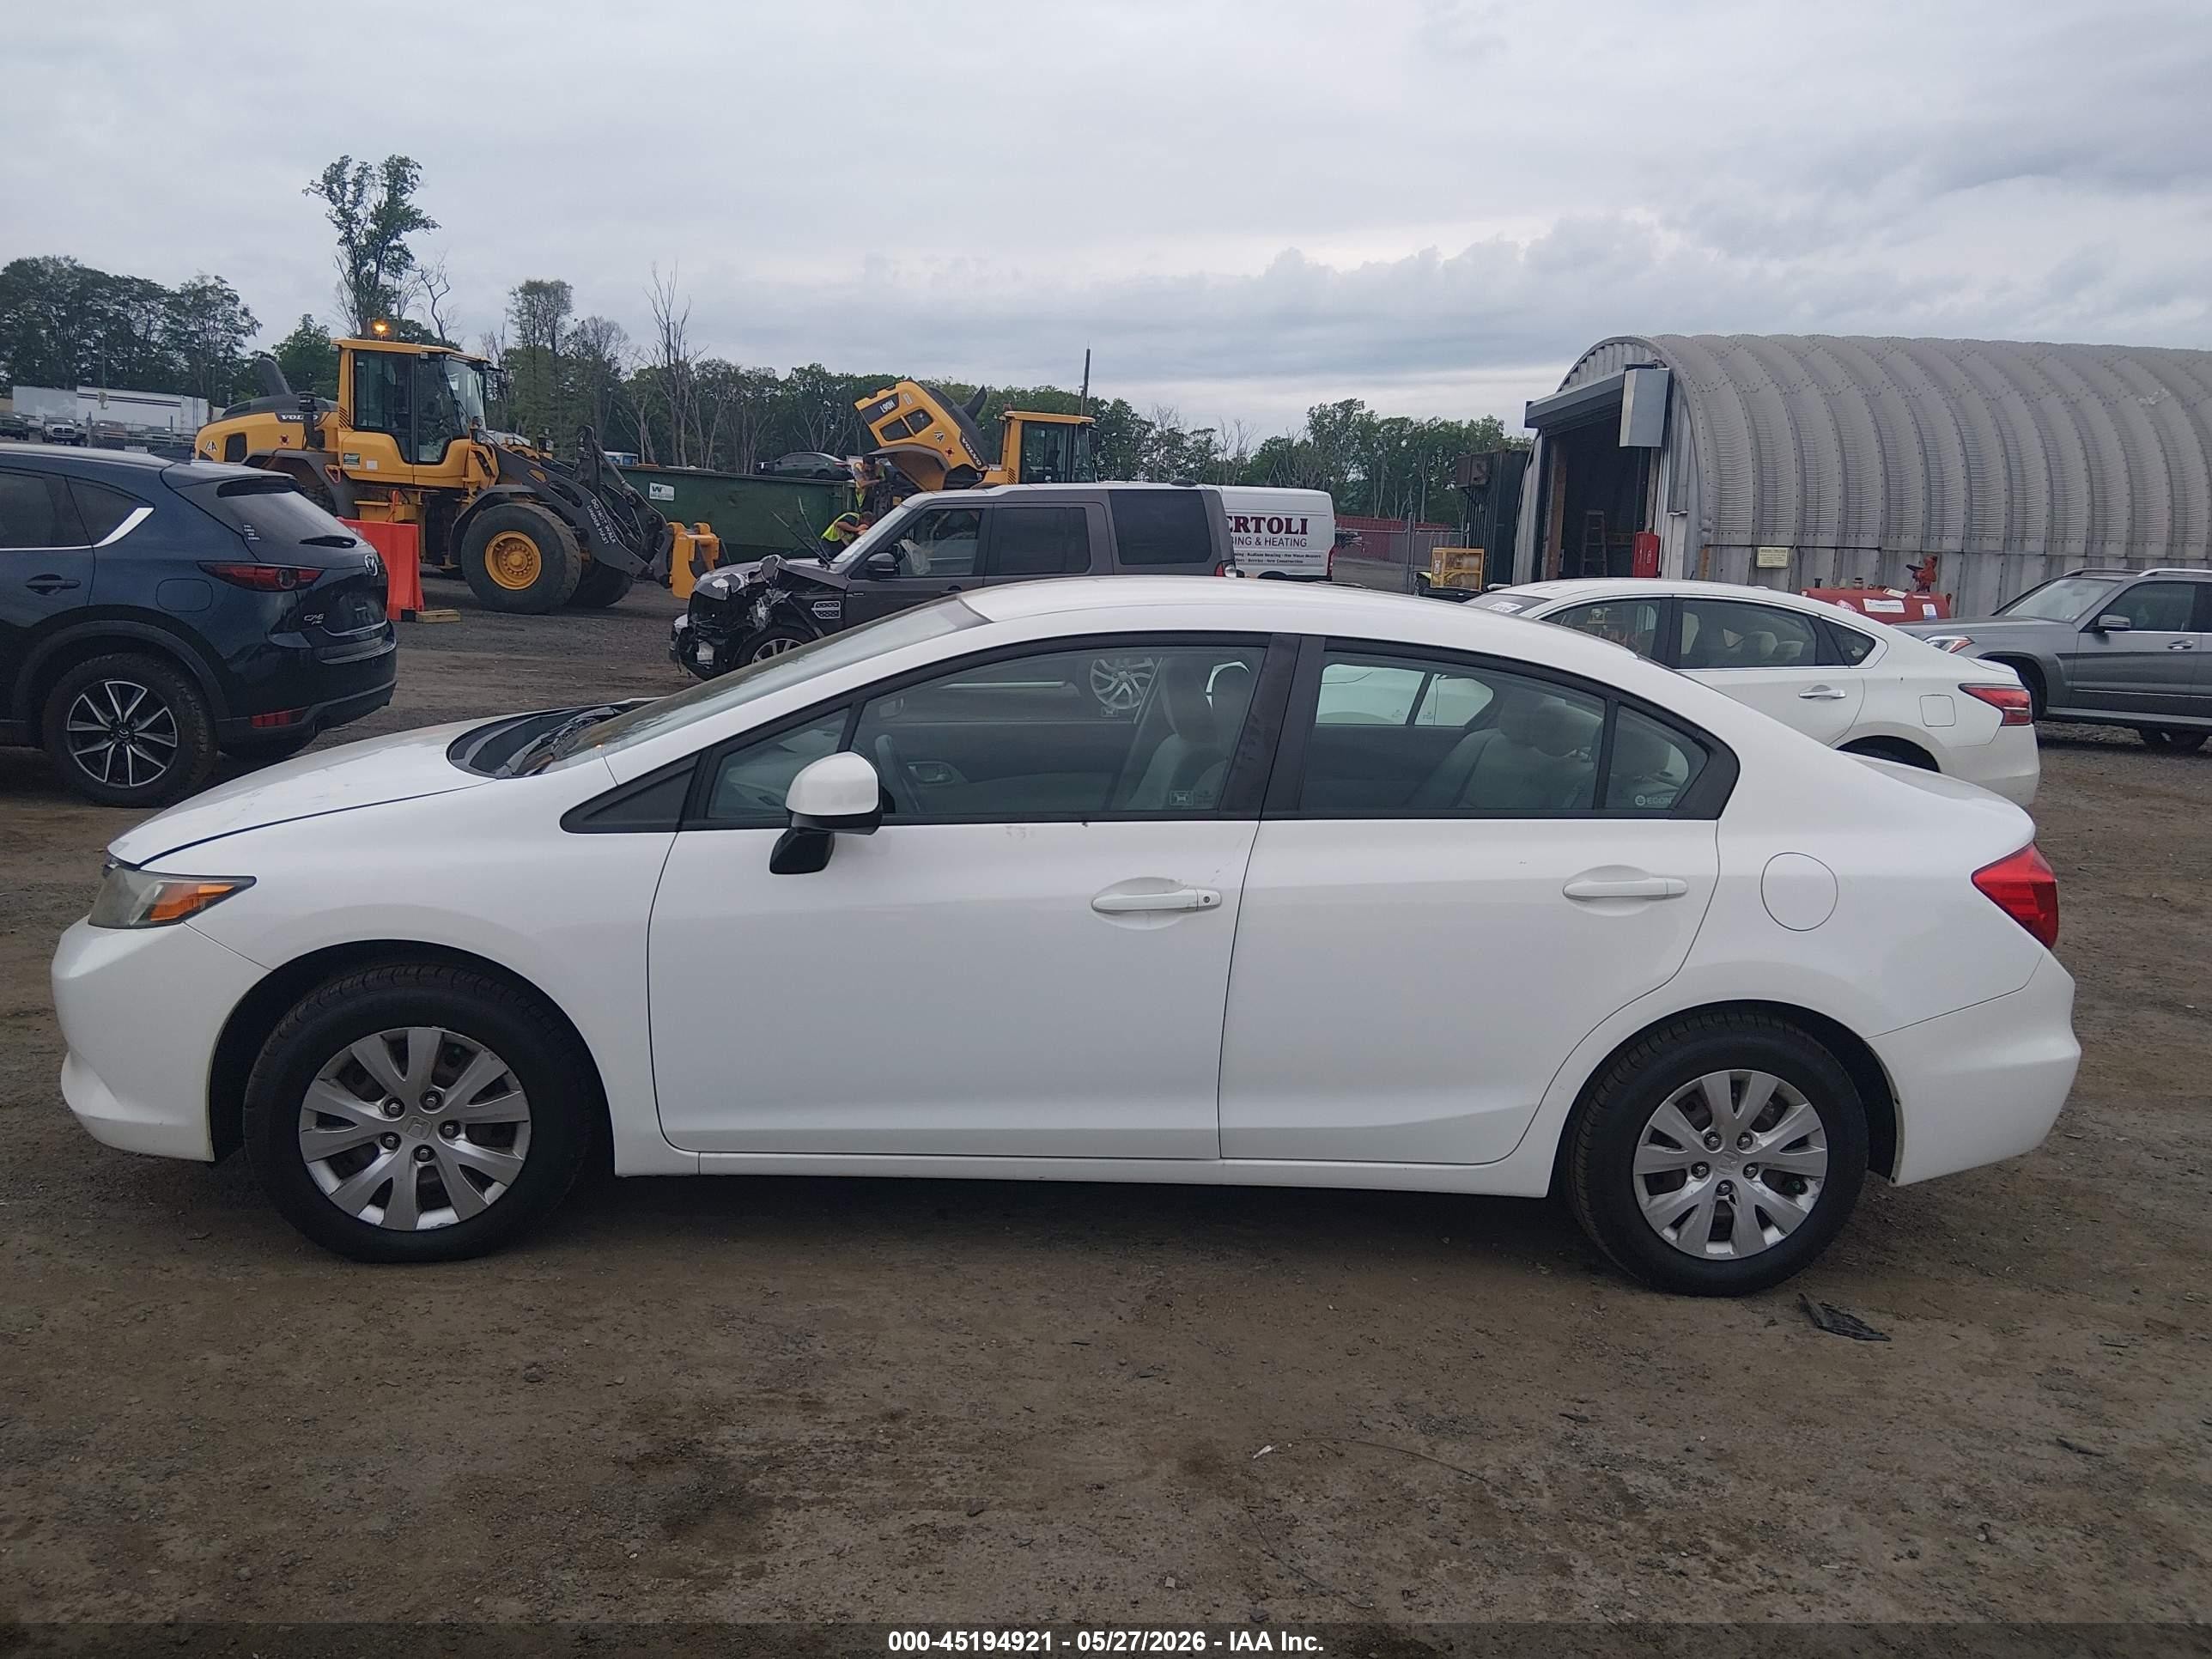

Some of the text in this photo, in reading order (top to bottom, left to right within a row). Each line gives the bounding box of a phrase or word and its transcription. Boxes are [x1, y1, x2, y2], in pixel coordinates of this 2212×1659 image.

[962, 437, 982, 466] VOLVO
[586, 506, 609, 544] UNDER MAST
[591, 499, 617, 544] DO NOT WALK
[1255, 537, 1262, 546] &
[1264, 538, 1308, 548] HEATING
